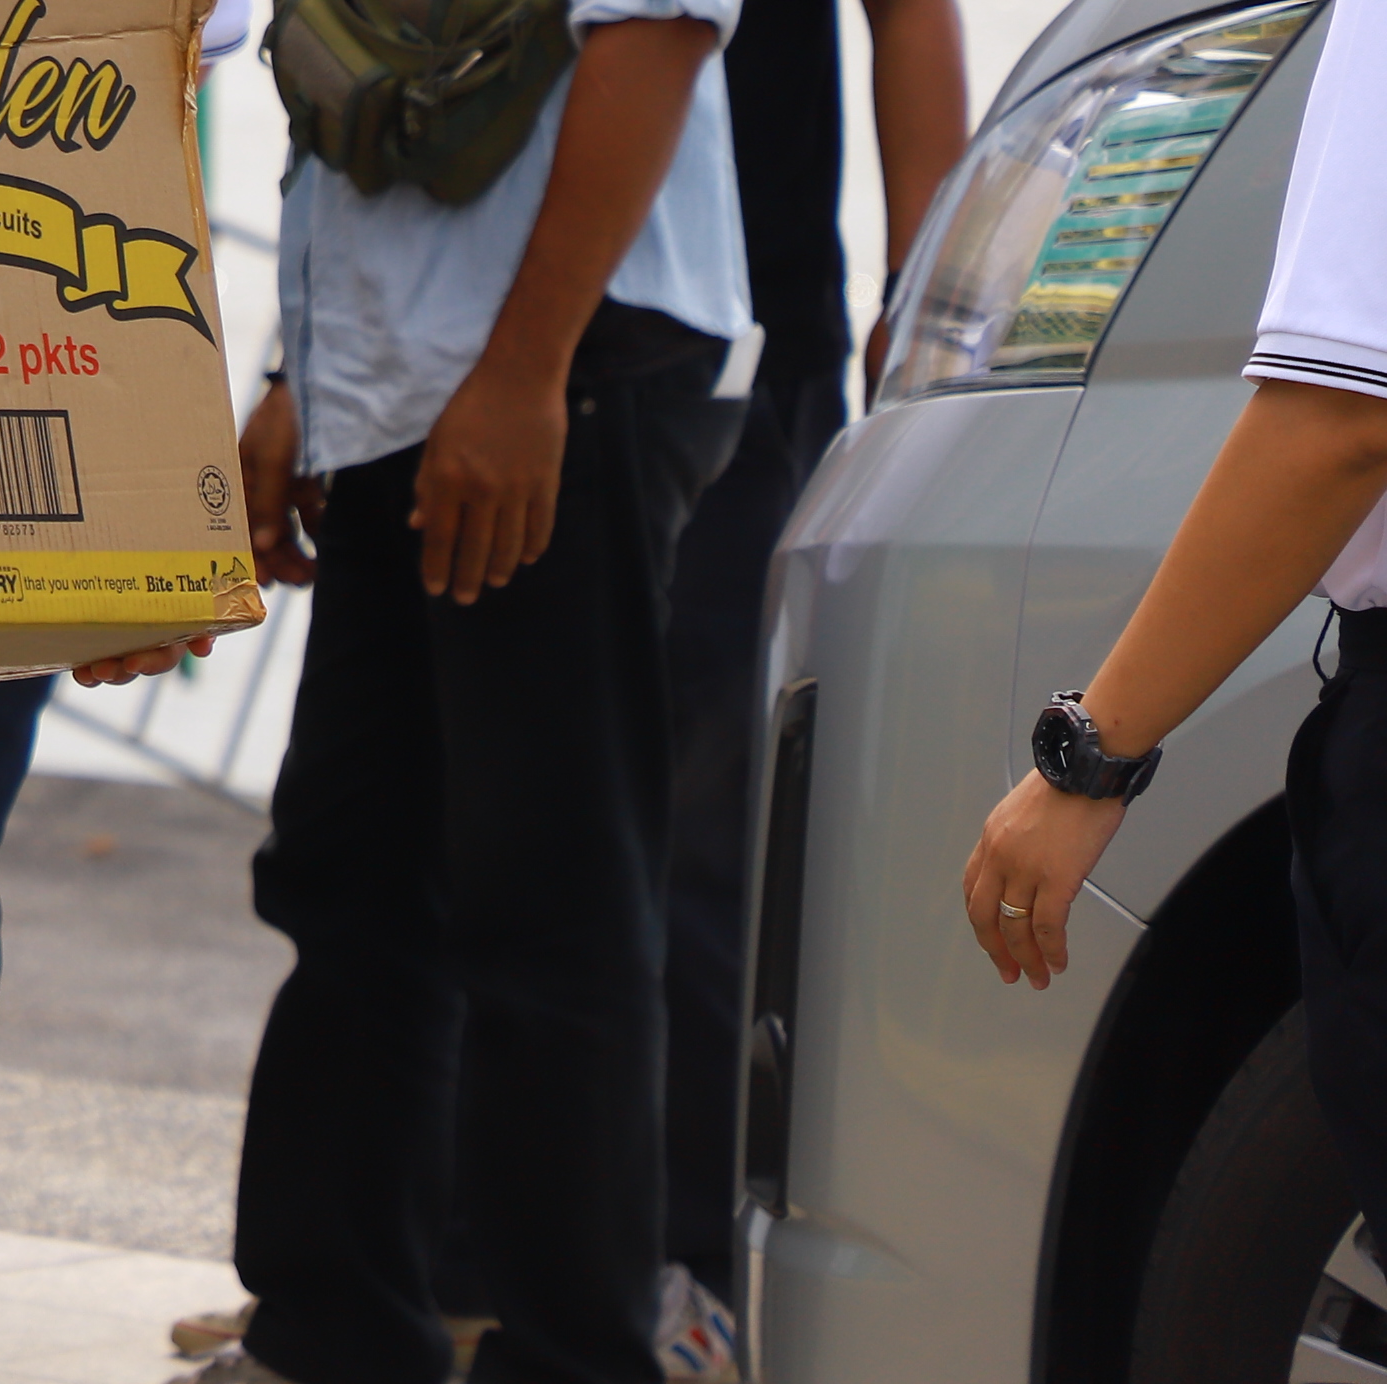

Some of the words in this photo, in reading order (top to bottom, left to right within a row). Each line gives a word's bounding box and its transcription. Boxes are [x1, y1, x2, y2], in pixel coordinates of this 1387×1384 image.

[19, 332, 100, 385] pkts
[24, 576, 46, 591] that
[48, 578, 69, 595] you
[73, 575, 103, 592] won't
[105, 576, 140, 595] regret.
[146, 574, 173, 593] Bite
